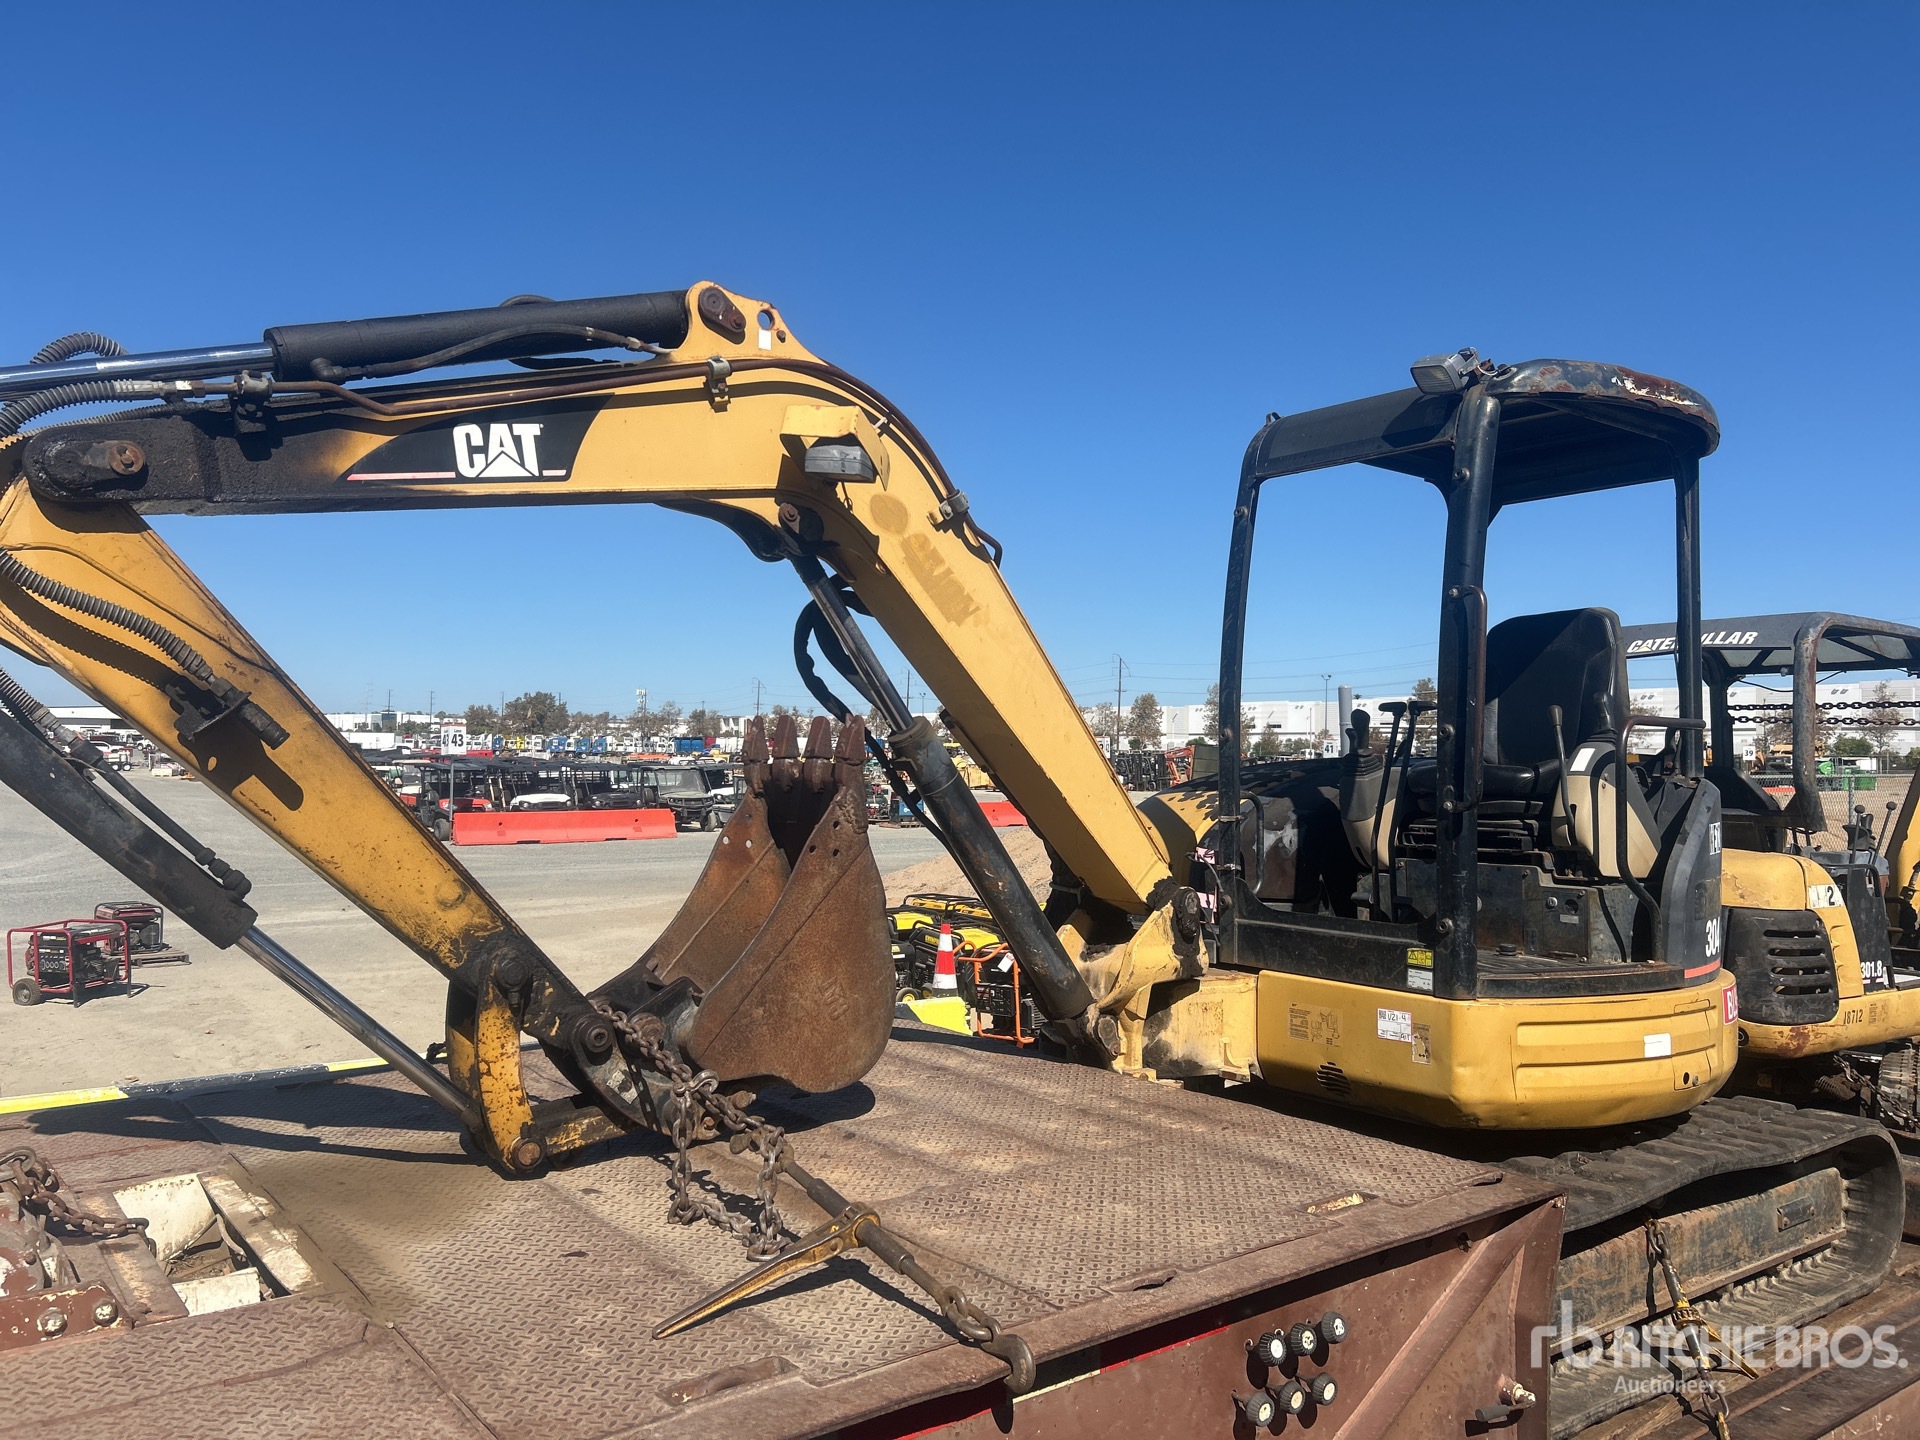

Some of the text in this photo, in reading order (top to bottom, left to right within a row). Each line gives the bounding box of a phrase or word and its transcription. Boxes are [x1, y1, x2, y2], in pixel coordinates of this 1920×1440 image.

[453, 423, 542, 478] CAT
[1627, 631, 1759, 653] CATEILLAR
[451, 734, 464, 746] 43
[1324, 744, 1334, 754] 41
[1744, 749, 1754, 757] 39
[1860, 960, 1883, 979] 301.8
